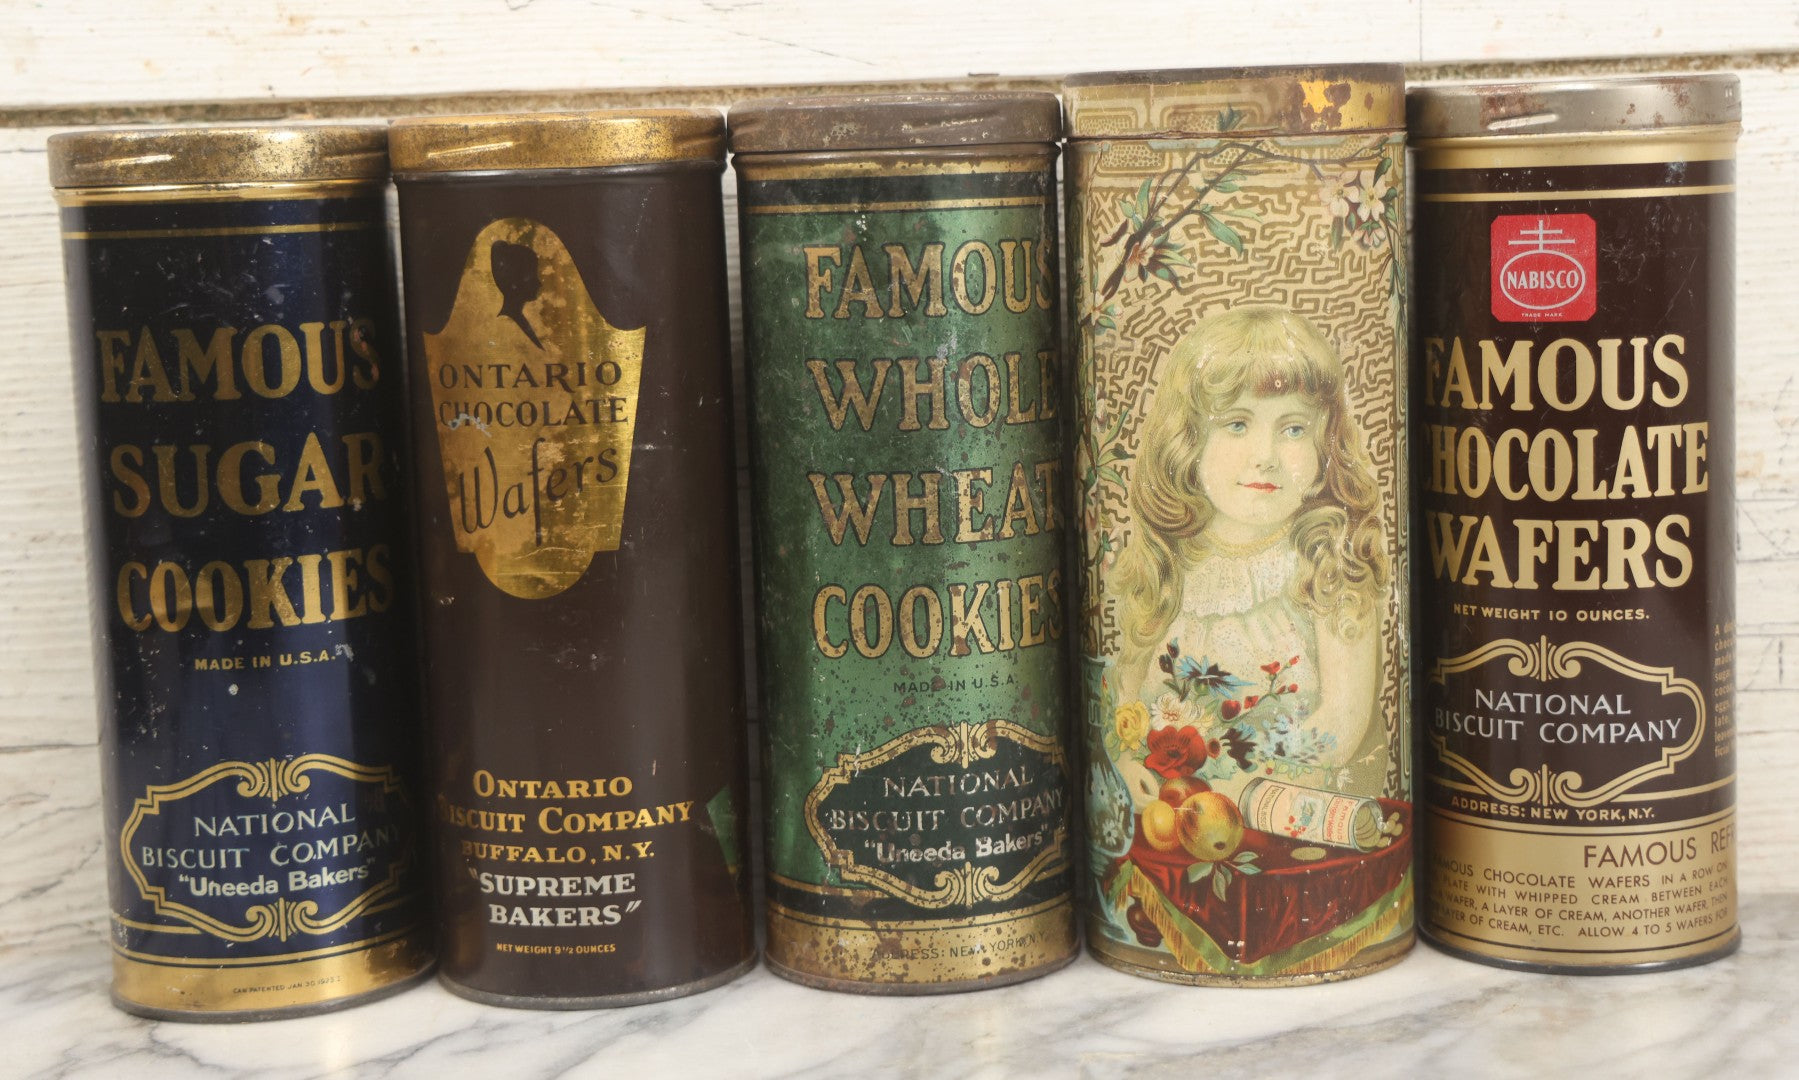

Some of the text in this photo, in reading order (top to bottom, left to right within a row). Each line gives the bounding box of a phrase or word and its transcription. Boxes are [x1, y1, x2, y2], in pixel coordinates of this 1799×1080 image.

[803, 237, 1054, 319] FAMOUS
[1507, 269, 1579, 290] NABISCO
[96, 319, 380, 402] FAMOUS
[1424, 334, 1689, 412] FAMOUS
[438, 360, 622, 393] ONTARIO
[805, 349, 1060, 431] WHOLE
[439, 397, 628, 427] CHOCOLATE
[110, 432, 388, 518] SUGAR
[459, 438, 619, 547] Wafers
[806, 458, 1064, 547] WHEAT
[1425, 510, 1693, 590] WAFERS
[117, 544, 395, 632] COOKIES
[812, 568, 1063, 660] COOKIES
[1453, 603, 1650, 622] NET WEIGHT 10 OUNCES.
[195, 650, 336, 670] MADE IN U.S.A.
[950, 680, 965, 692] IN
[1474, 688, 1631, 716] NATIONAL
[1435, 708, 1525, 742] BISCUIT
[1539, 718, 1682, 744] COMPANY
[472, 770, 633, 799] ONTARIO
[883, 765, 1033, 798] NATIONAL
[193, 803, 355, 837] NATIONAL
[538, 801, 694, 834] COMPANY
[829, 788, 1064, 831] BISCUIT COMPANY
[1451, 796, 1655, 823] ADDRESS: NEW YORK, N.Y.
[142, 846, 249, 869] BISCUIT
[461, 840, 655, 864] BUFFALO, N.Y.
[1584, 837, 1697, 868] FAMOUS
[179, 857, 376, 897] "Uneeda Bakers"
[468, 867, 636, 896] "SUPREME
[1483, 868, 1576, 888] CHOCOLATE
[1588, 875, 1650, 888] WAFERS
[1661, 873, 1673, 885] IN
[1680, 873, 1687, 882] A
[1692, 867, 1713, 880] ROW
[1717, 861, 1728, 873] ON
[1476, 885, 1506, 899] WITH
[1515, 890, 1578, 904] WHIPPED
[1591, 894, 1640, 905] CREAM
[1651, 886, 1702, 902] BETWEEN
[1709, 877, 1728, 892] EACH
[489, 900, 642, 927] BAKERS"
[1469, 914, 1483, 926] OF
[1488, 918, 1532, 935] CREAM,
[1537, 924, 1564, 936] ETC.
[1578, 926, 1625, 938] ALLOW
[1632, 926, 1639, 936] 4
[1644, 924, 1660, 936] TO
[1665, 922, 1672, 933] 5
[1676, 914, 1713, 930] WAFERS
[1481, 902, 1489, 912] A
[1493, 903, 1528, 917] LAYER
[1535, 908, 1552, 919] OF
[1558, 910, 1607, 922] CREAM,
[1612, 906, 1670, 921] ANOTHER
[496, 943, 512, 953] NET
[514, 945, 552, 954] WEIGHT
[575, 943, 616, 954] OUNCES
[870, 948, 945, 960] ARESS:
[950, 945, 987, 957] NE
